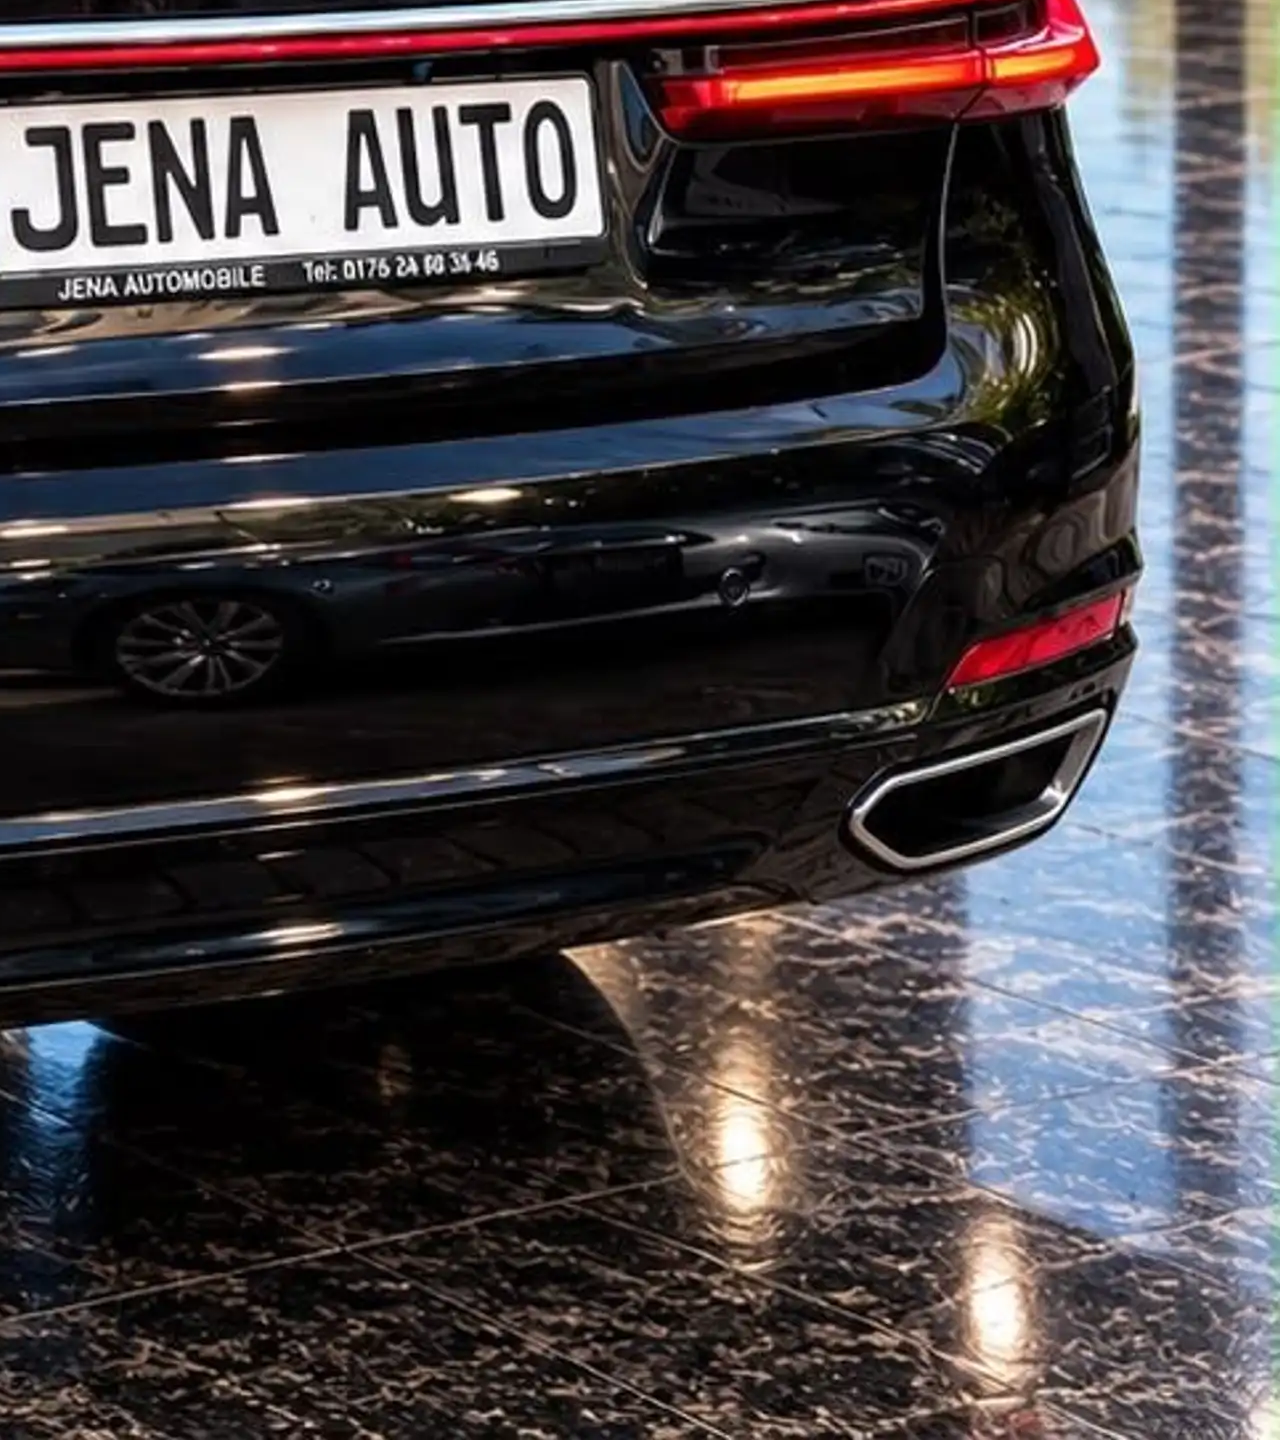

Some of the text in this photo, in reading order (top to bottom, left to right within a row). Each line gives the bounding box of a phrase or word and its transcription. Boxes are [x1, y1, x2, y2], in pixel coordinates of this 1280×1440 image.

[11, 98, 578, 252] JENA AUTO
[57, 275, 119, 301] JENA
[123, 264, 267, 297] AUTOMOBILE
